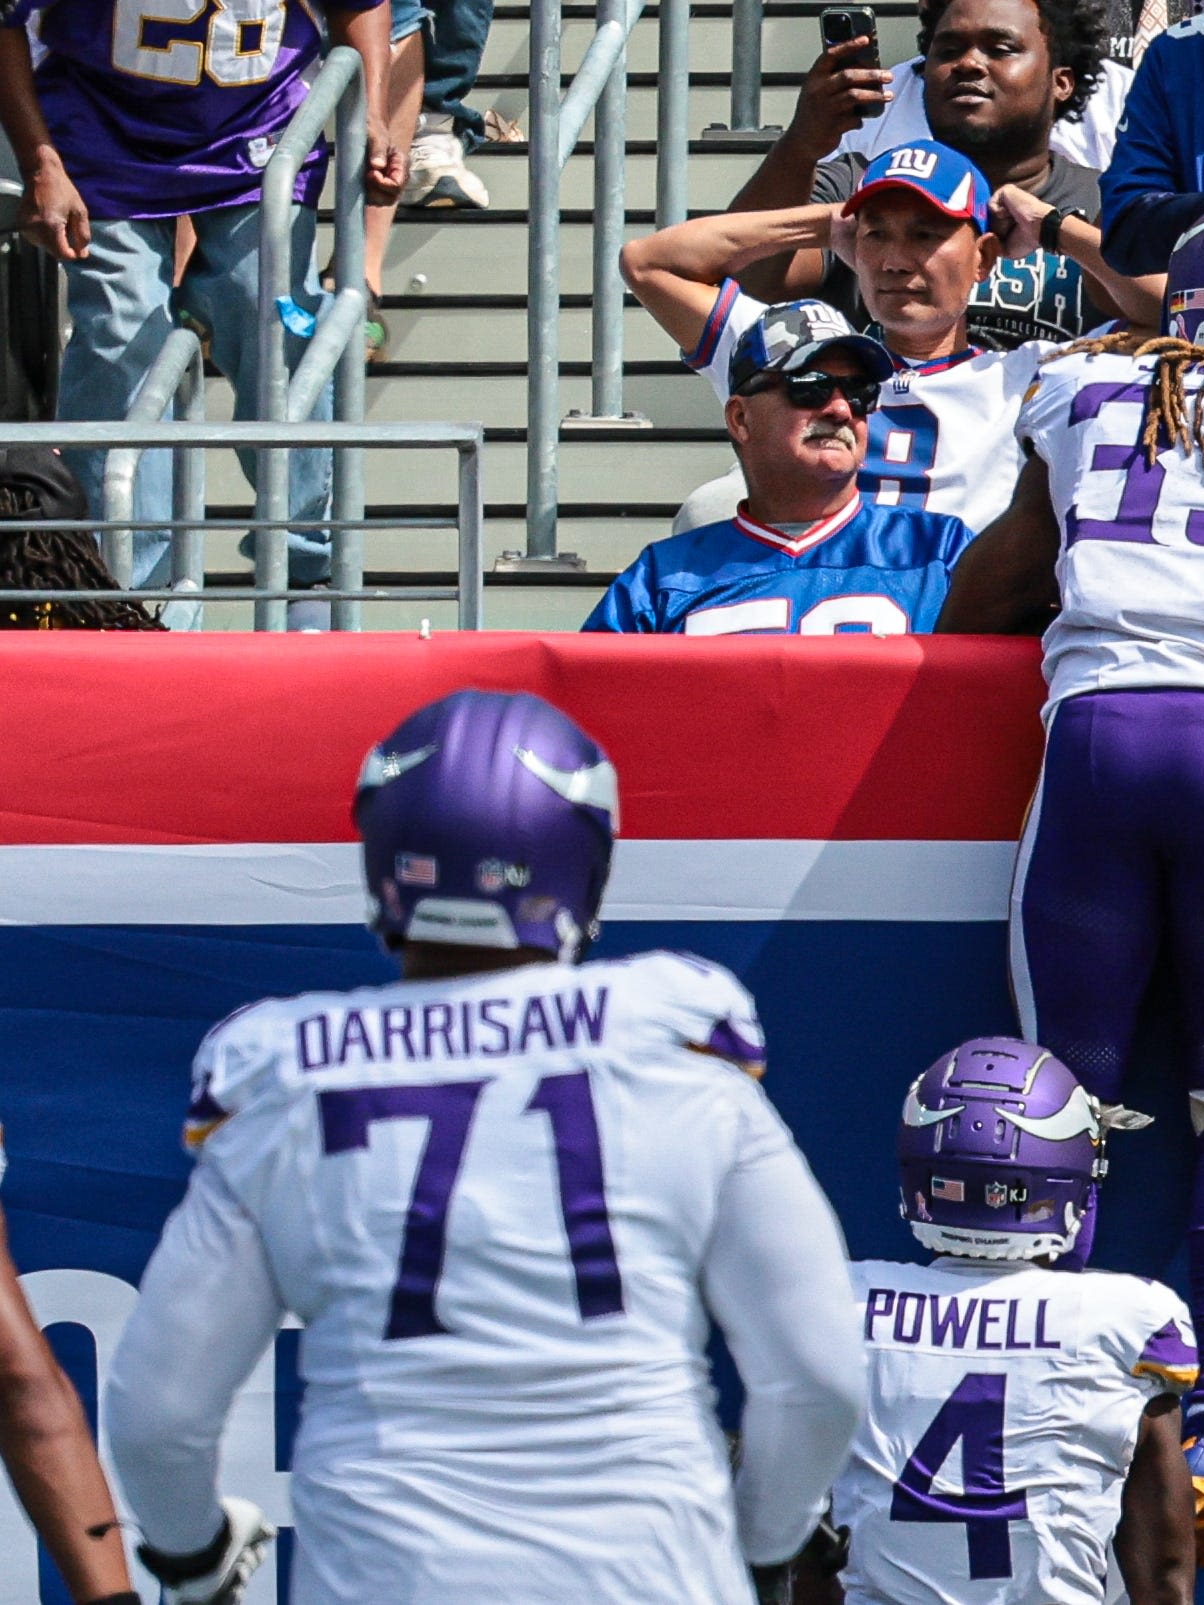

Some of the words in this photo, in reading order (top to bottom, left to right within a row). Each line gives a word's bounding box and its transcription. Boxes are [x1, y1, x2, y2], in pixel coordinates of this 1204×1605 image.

[112, 0, 288, 88] 28
[297, 986, 609, 1070] DARRISAW
[315, 1067, 628, 1342] 71
[1009, 1187, 1027, 1203] KJ
[864, 1287, 1062, 1350] POWELL
[889, 1372, 1030, 1581] 4
